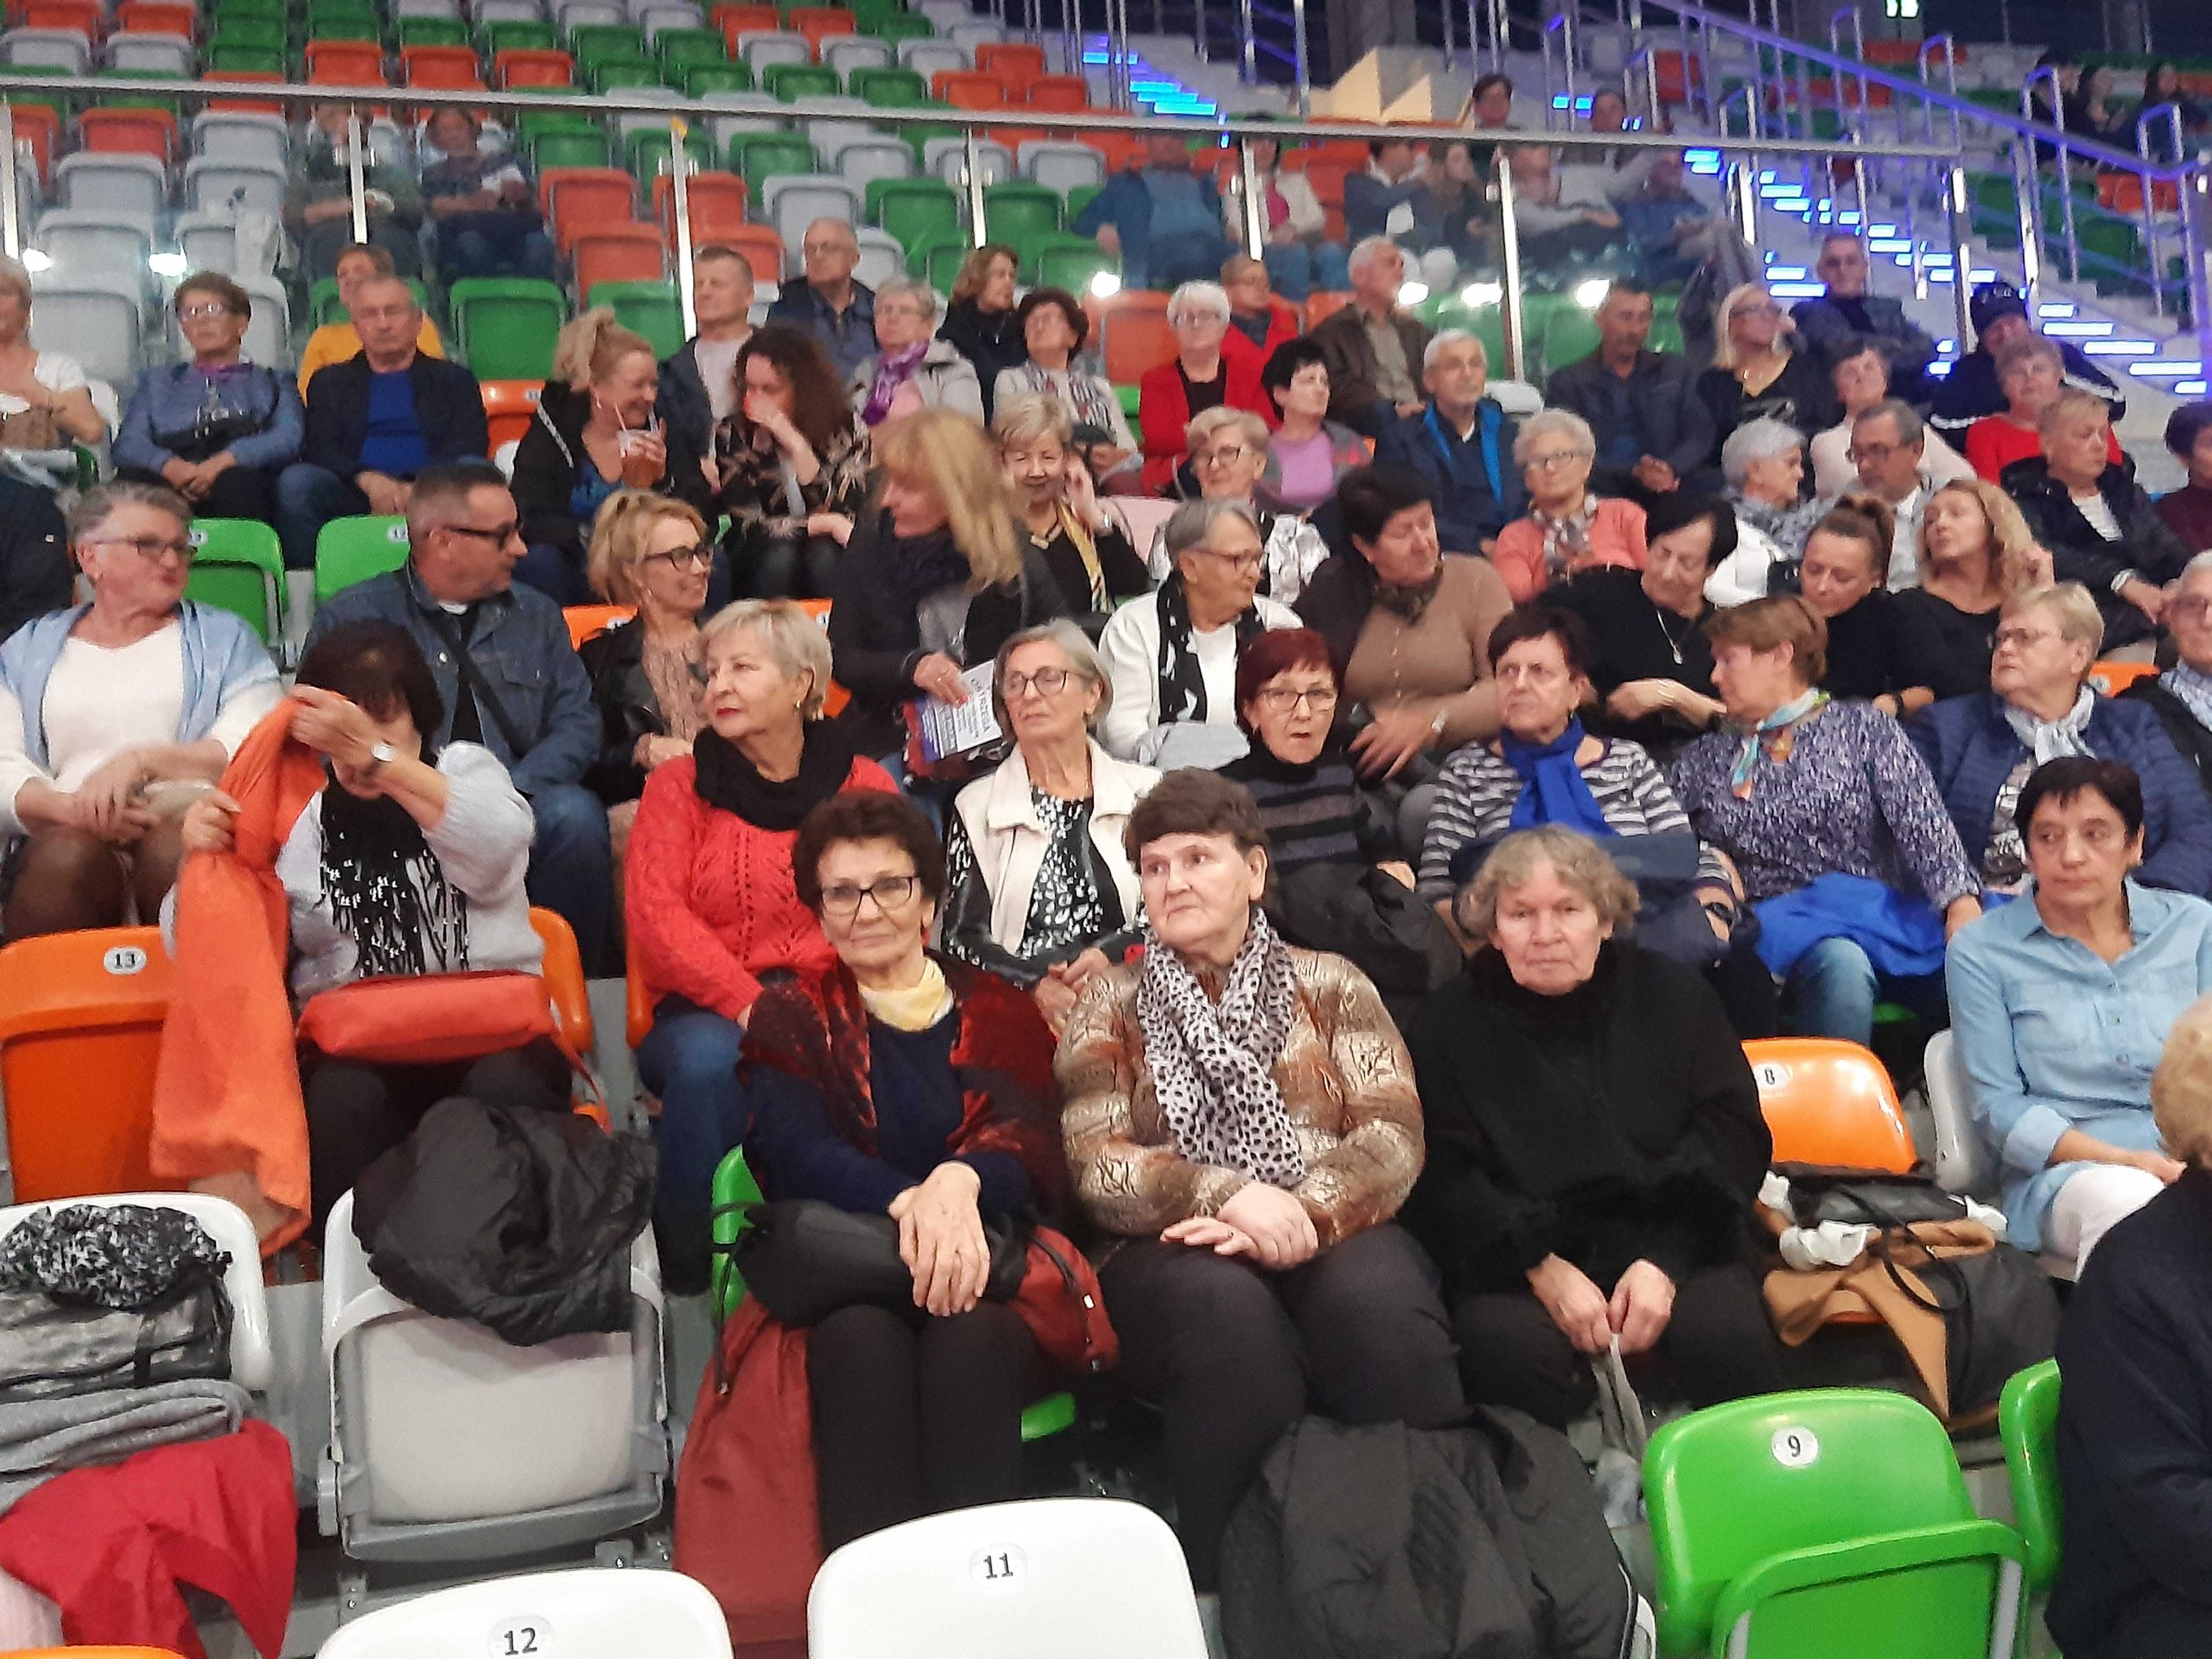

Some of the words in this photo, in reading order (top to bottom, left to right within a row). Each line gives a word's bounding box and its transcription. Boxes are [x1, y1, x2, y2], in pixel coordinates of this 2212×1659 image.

[114, 951, 137, 969] 13
[1787, 1434, 1801, 1458] 9
[983, 1553, 1014, 1580] 11
[504, 1627, 537, 1656] 12
